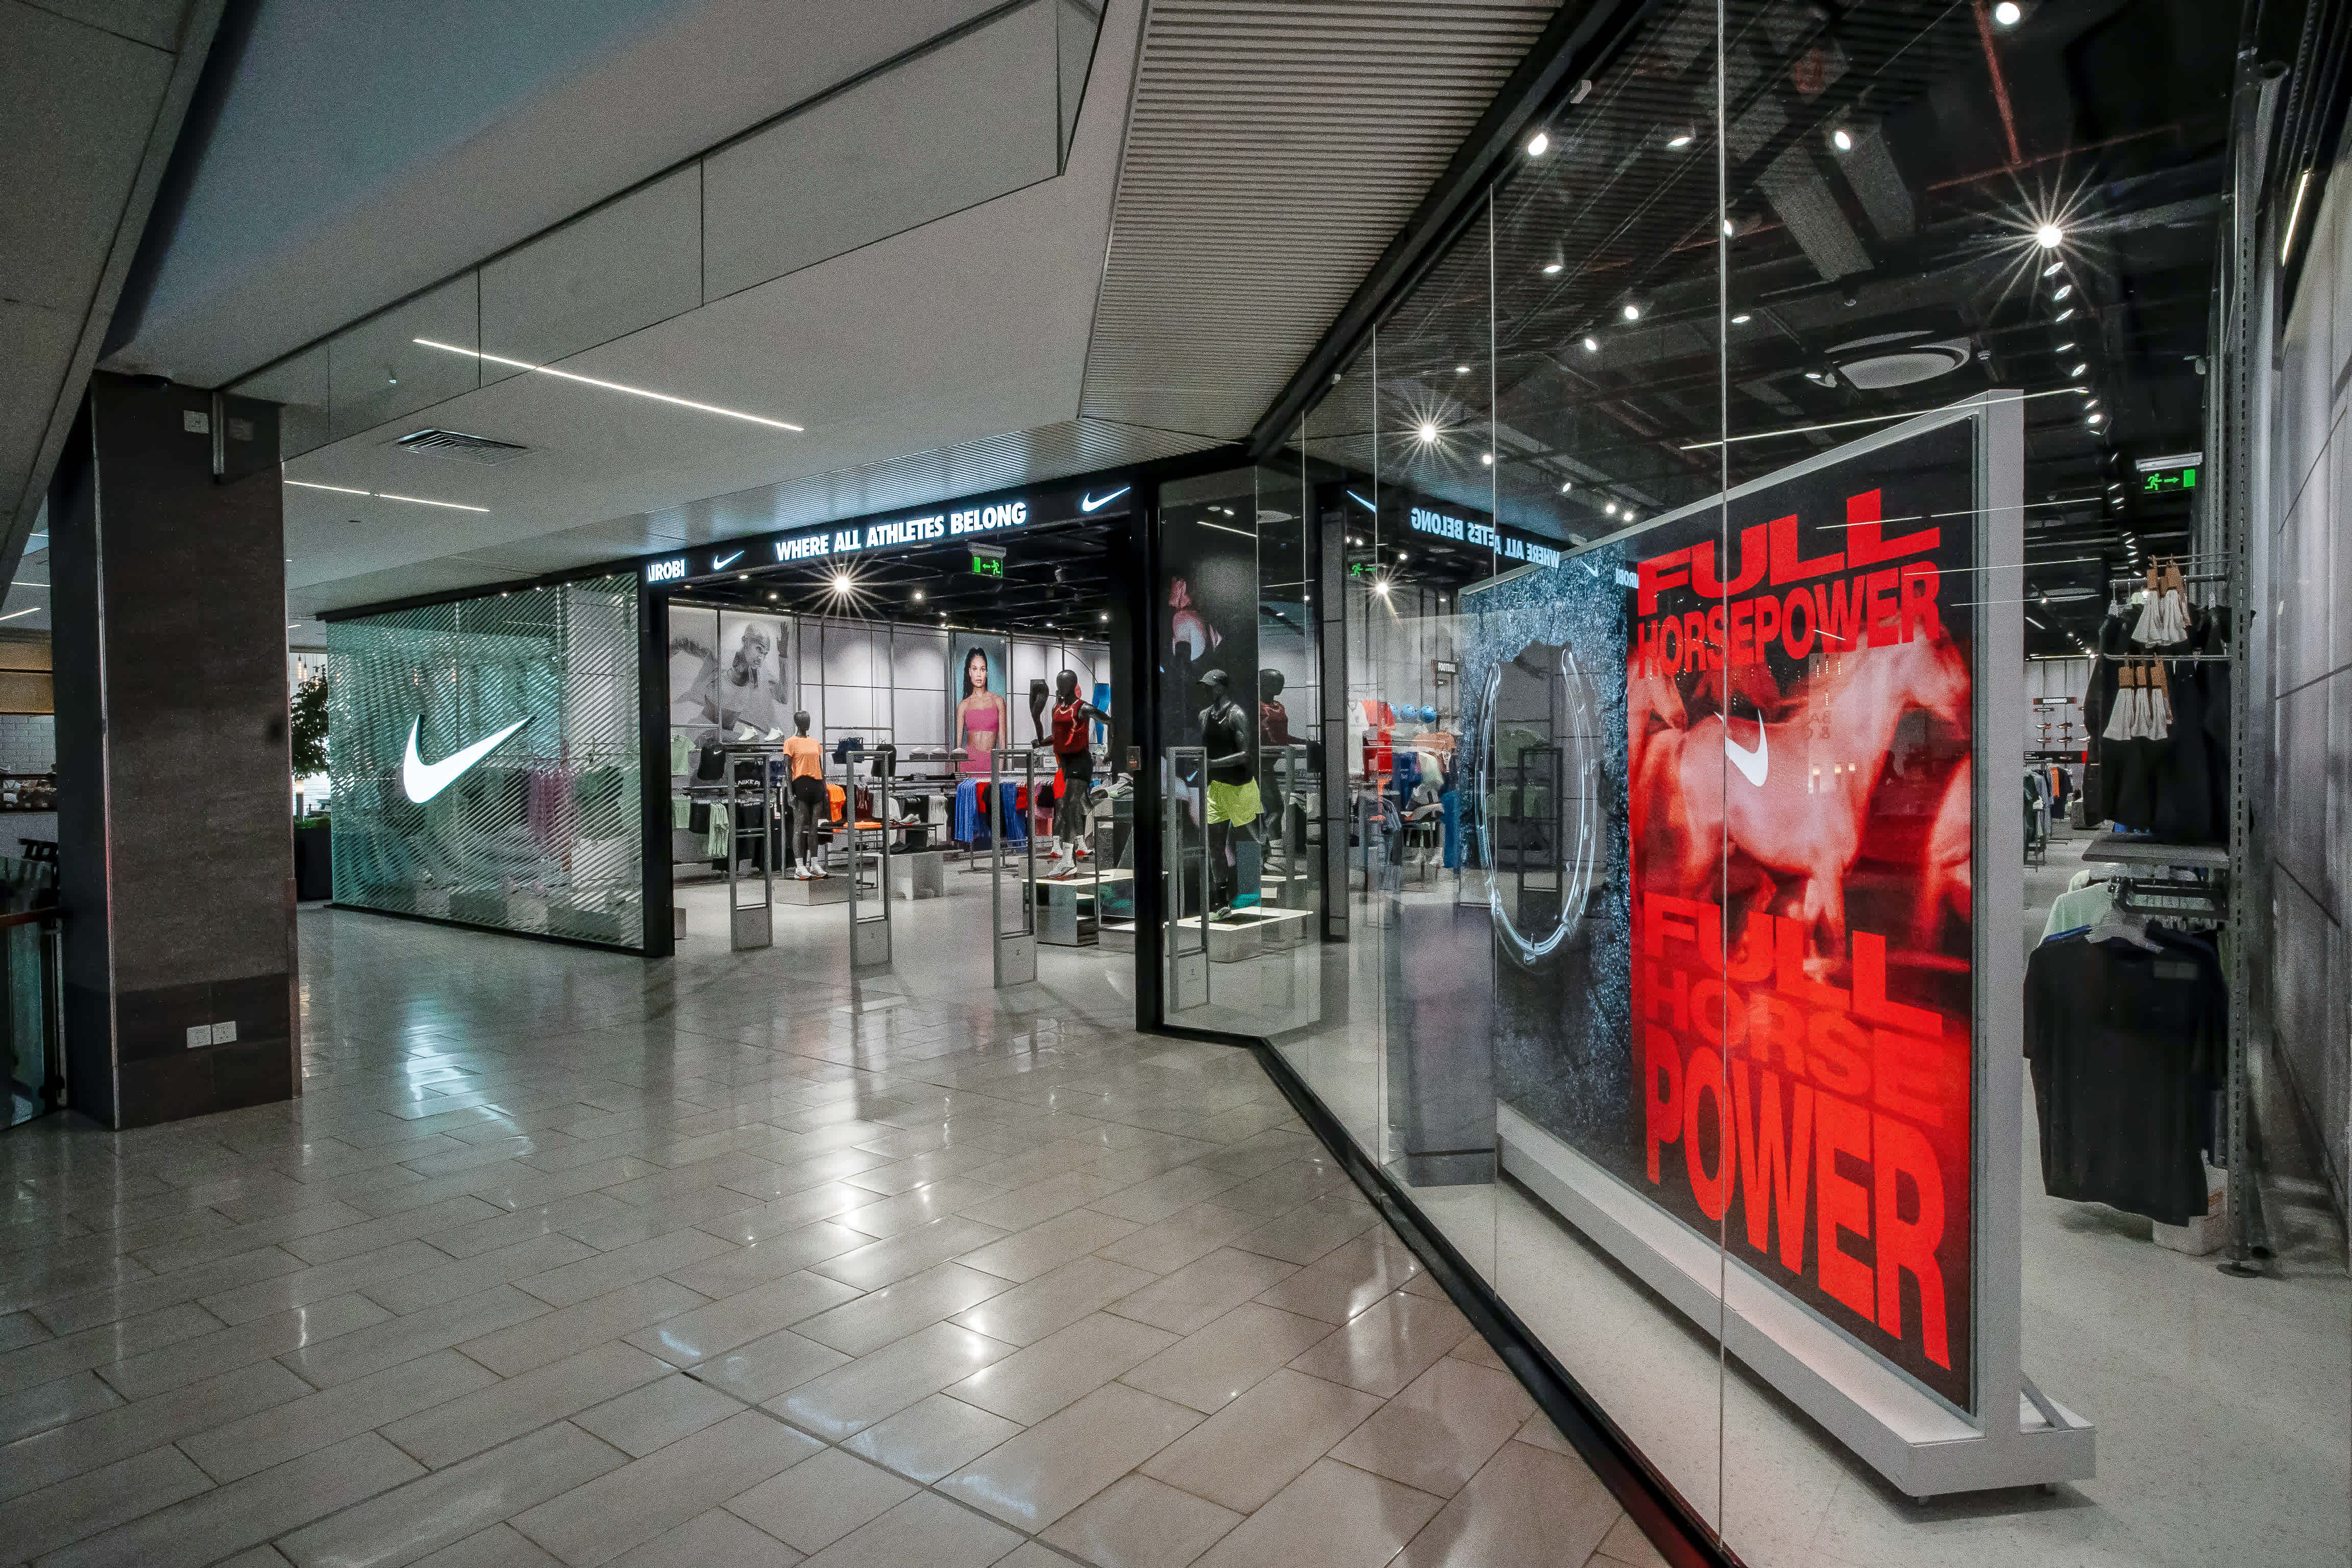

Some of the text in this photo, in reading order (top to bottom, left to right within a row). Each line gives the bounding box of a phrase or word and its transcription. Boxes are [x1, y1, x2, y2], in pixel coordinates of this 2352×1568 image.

[775, 502, 1027, 561] WHERE ALL ATHLETES BELONG
[1637, 488, 1940, 617] FULL
[1638, 560, 1940, 679] HORSEPOWER
[1644, 891, 1943, 1038] FULL
[1644, 958, 1943, 1125] HORSE
[1645, 1024, 1951, 1371] POWER
